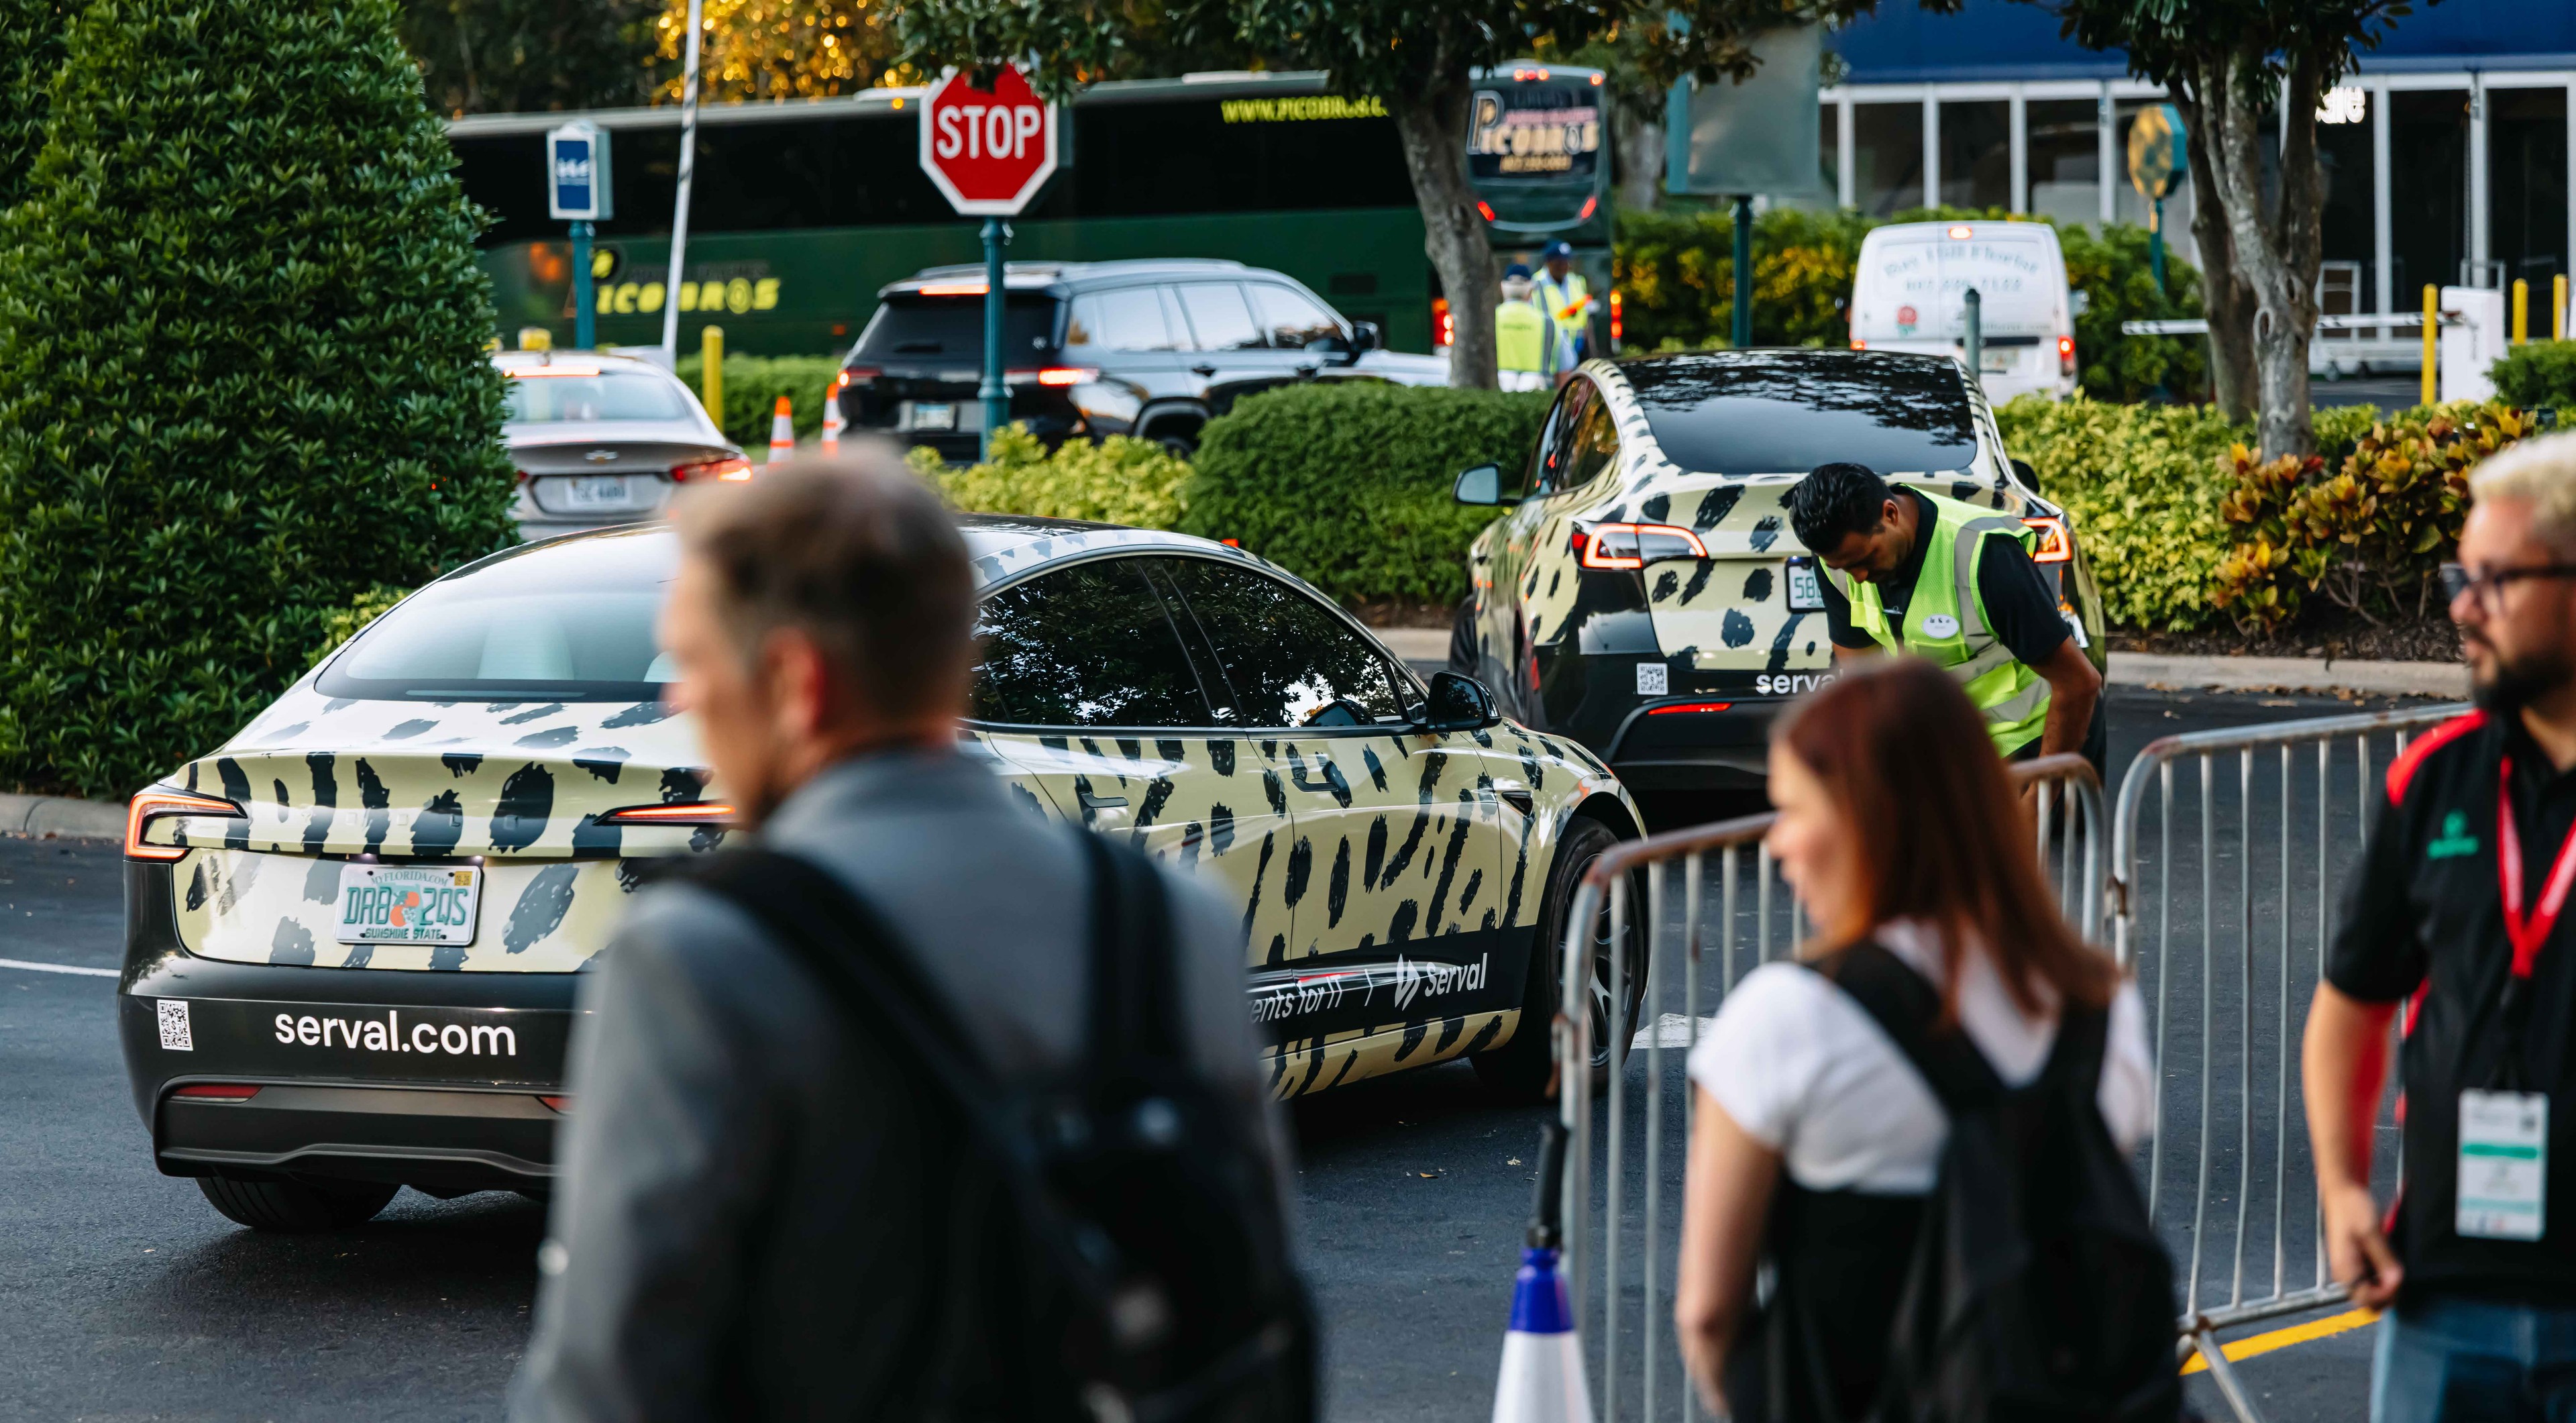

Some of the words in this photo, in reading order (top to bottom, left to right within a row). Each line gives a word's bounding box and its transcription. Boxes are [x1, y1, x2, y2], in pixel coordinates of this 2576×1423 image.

[936, 105, 1041, 159] STOP
[365, 928, 408, 939] SUNSHINE
[413, 929, 441, 940] STATE
[1297, 980, 1325, 1015] for
[1326, 975, 1344, 1009] IT
[1424, 952, 1487, 997] Serval
[275, 1010, 517, 1056] serval.com
